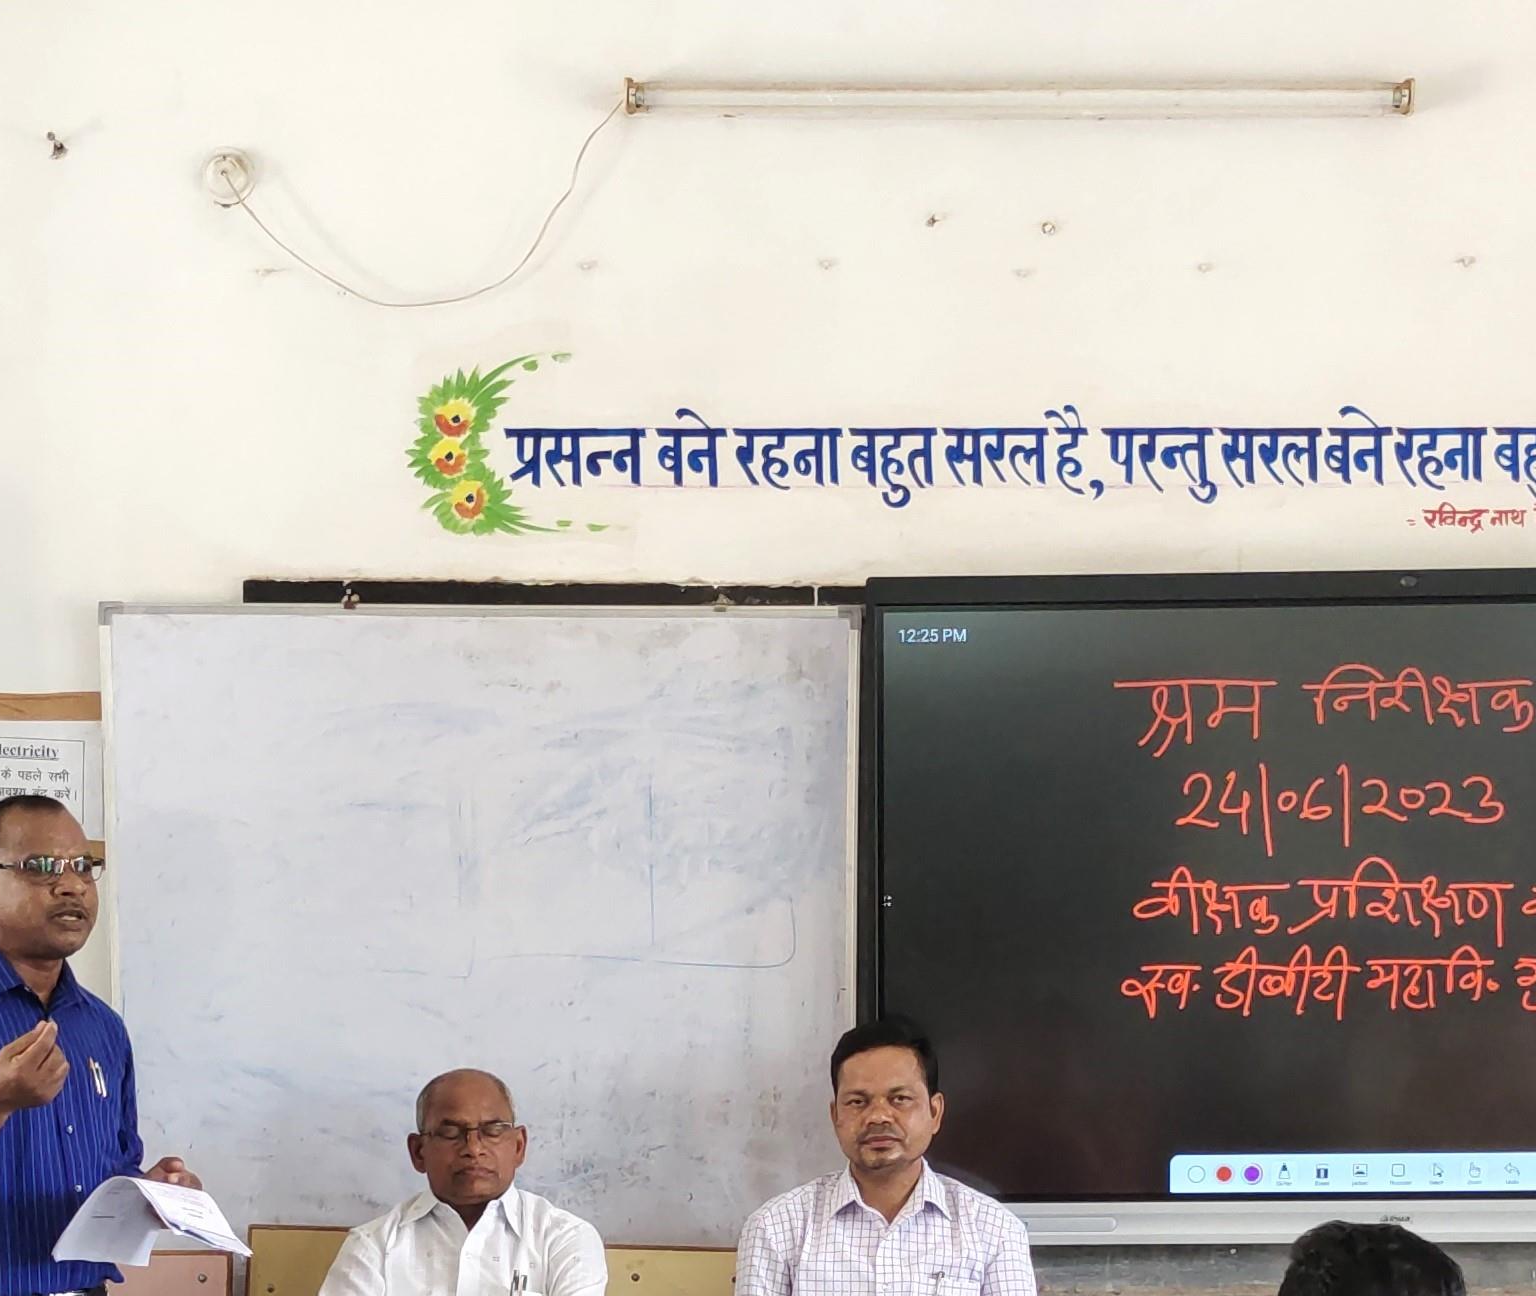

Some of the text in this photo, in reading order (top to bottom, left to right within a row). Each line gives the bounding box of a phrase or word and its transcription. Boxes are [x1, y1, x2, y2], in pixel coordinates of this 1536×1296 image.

[505, 427, 646, 487] प्रसन्न
[656, 408, 726, 487] बने
[735, 427, 842, 491] रहना
[849, 427, 936, 508] बहुत
[945, 426, 1046, 487] सरल
[1102, 426, 1216, 505] परन्तु
[1218, 427, 1321, 487] सरल
[1322, 405, 1393, 487] बने
[1395, 426, 1488, 489] रहना
[1490, 508, 1527, 527] नाथ
[897, 628, 967, 643] 12:25 PM
[1113, 678, 1279, 758] श्रम
[1302, 662, 1535, 735] निरीक्षक
[0, 765, 13, 780] के
[17, 767, 42, 782] पहले
[47, 768, 70, 784] सभी
